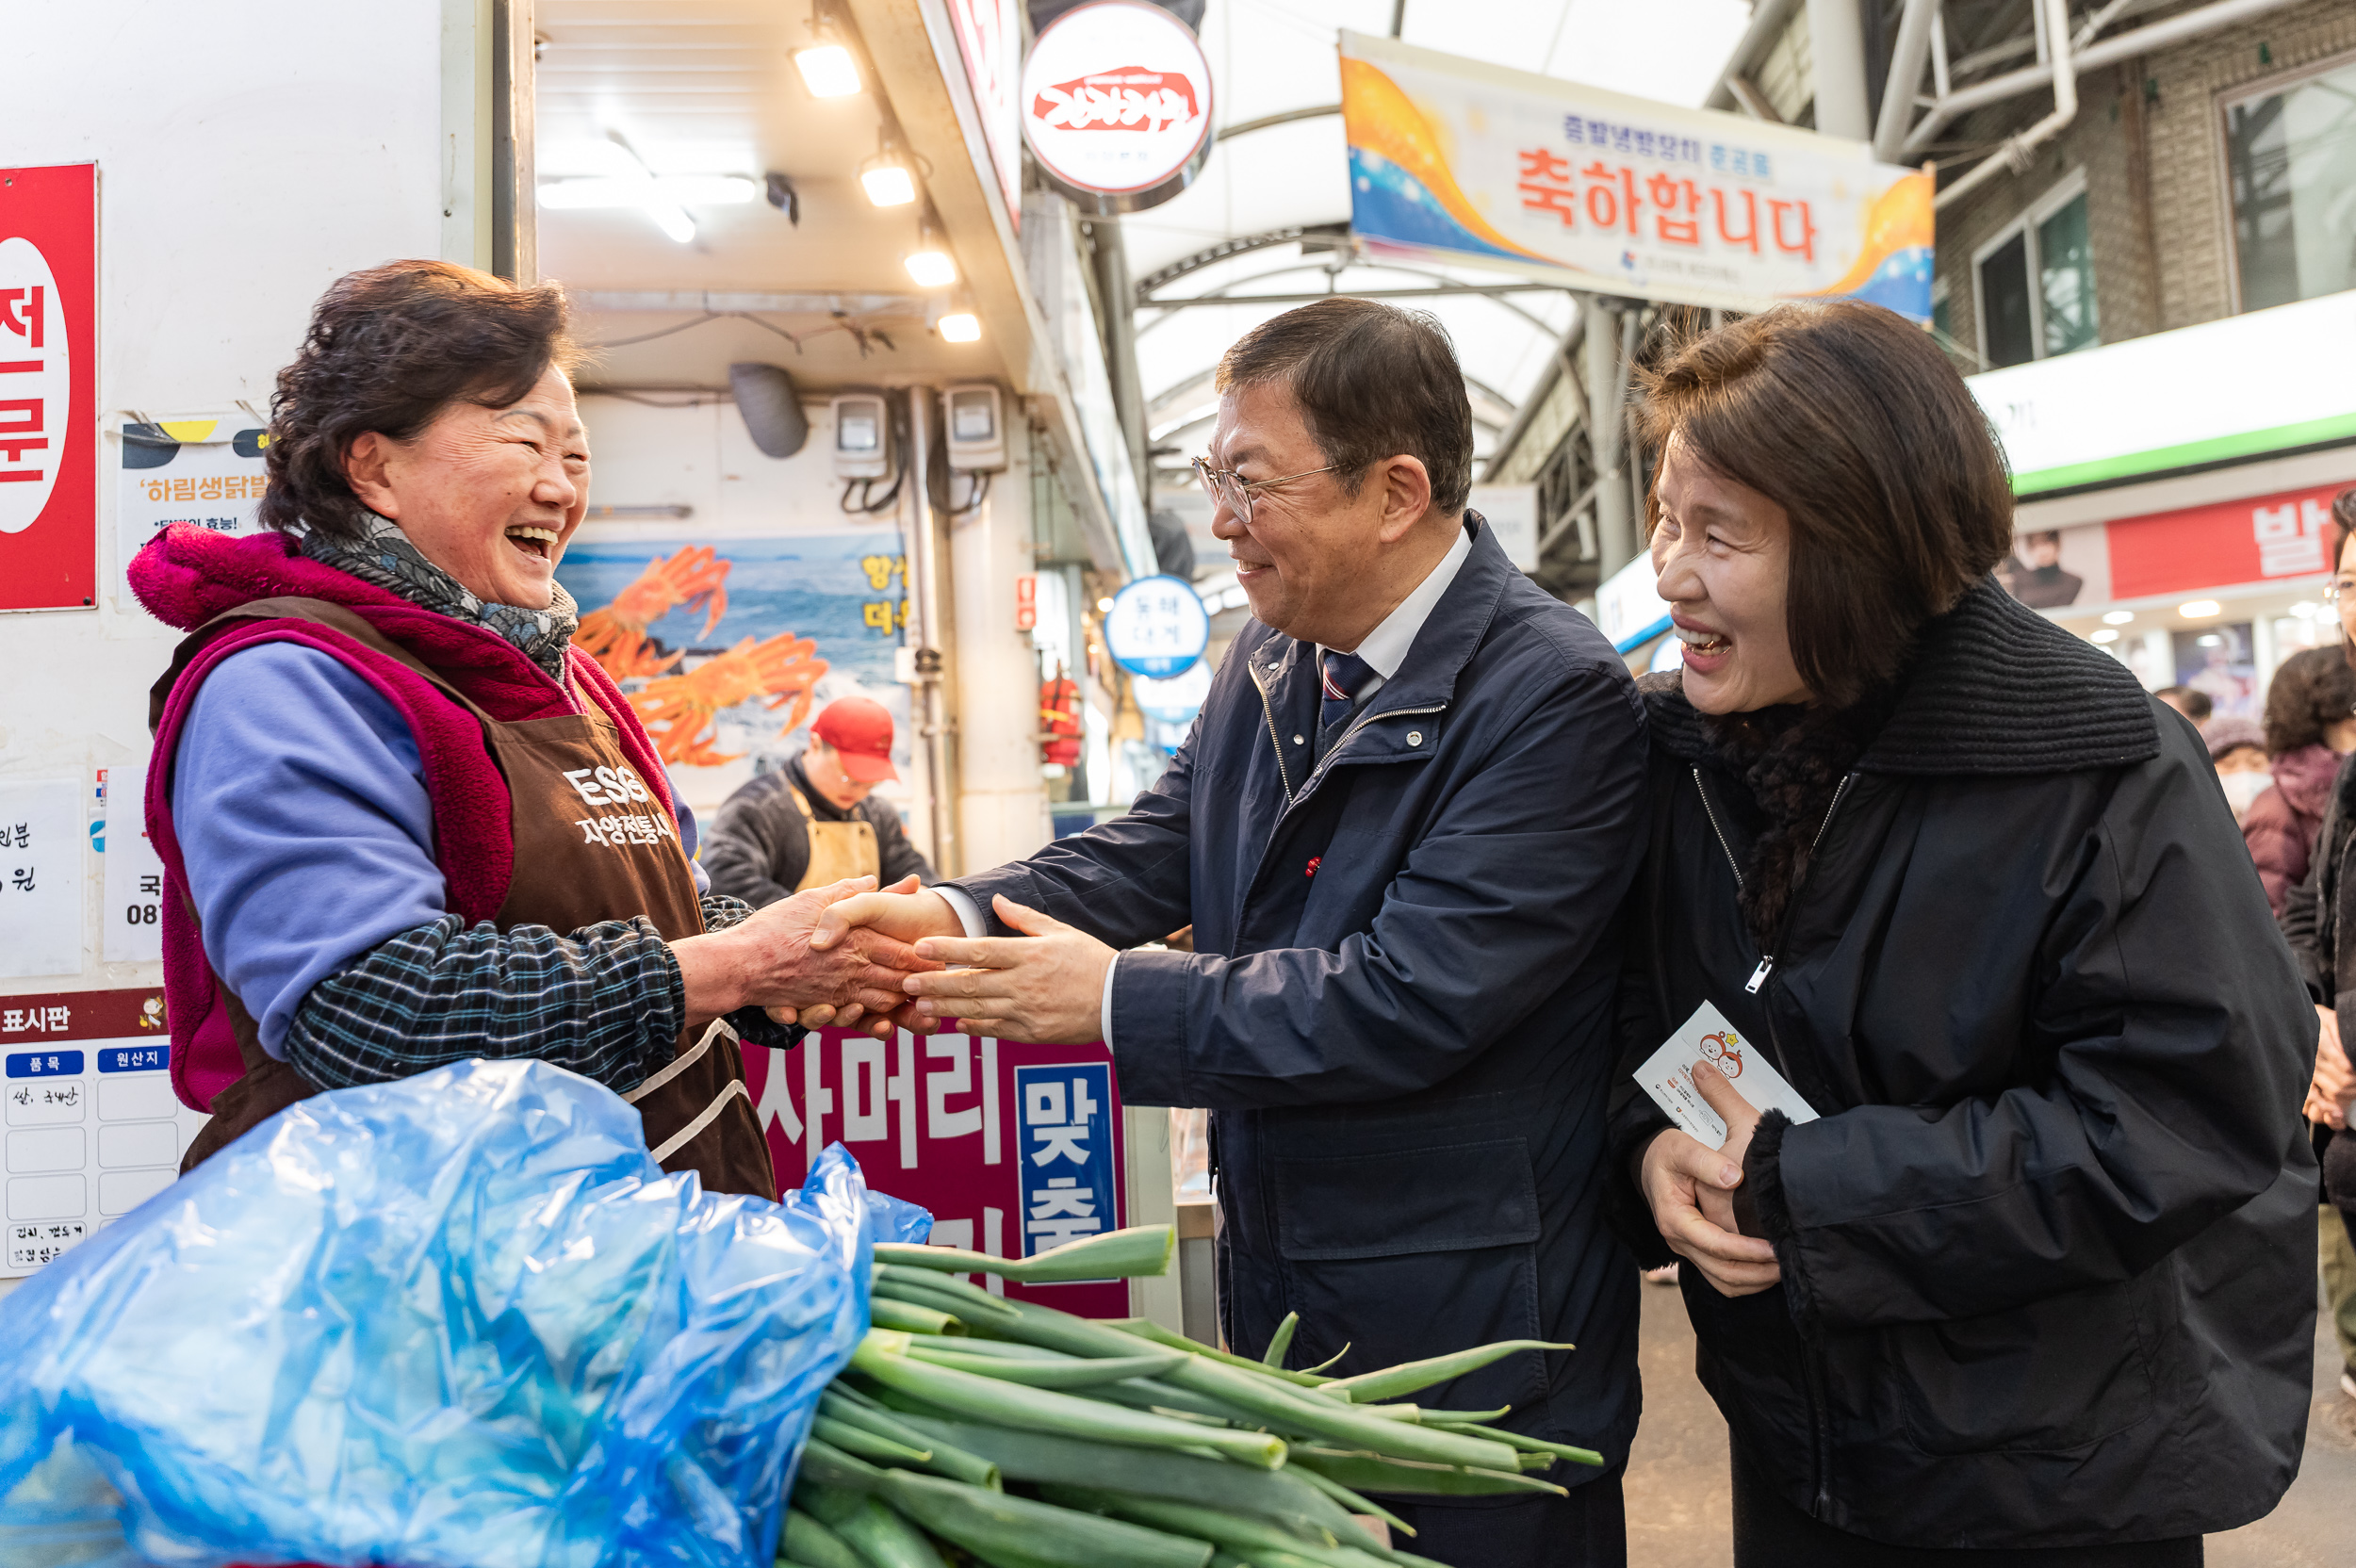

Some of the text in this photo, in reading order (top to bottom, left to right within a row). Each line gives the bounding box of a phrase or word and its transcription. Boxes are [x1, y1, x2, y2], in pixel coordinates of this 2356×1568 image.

[1516, 147, 1819, 264] 축하합니다
[563, 765, 649, 806] ESG
[2, 1005, 72, 1033] 표시판
[117, 1051, 158, 1068] 원산지
